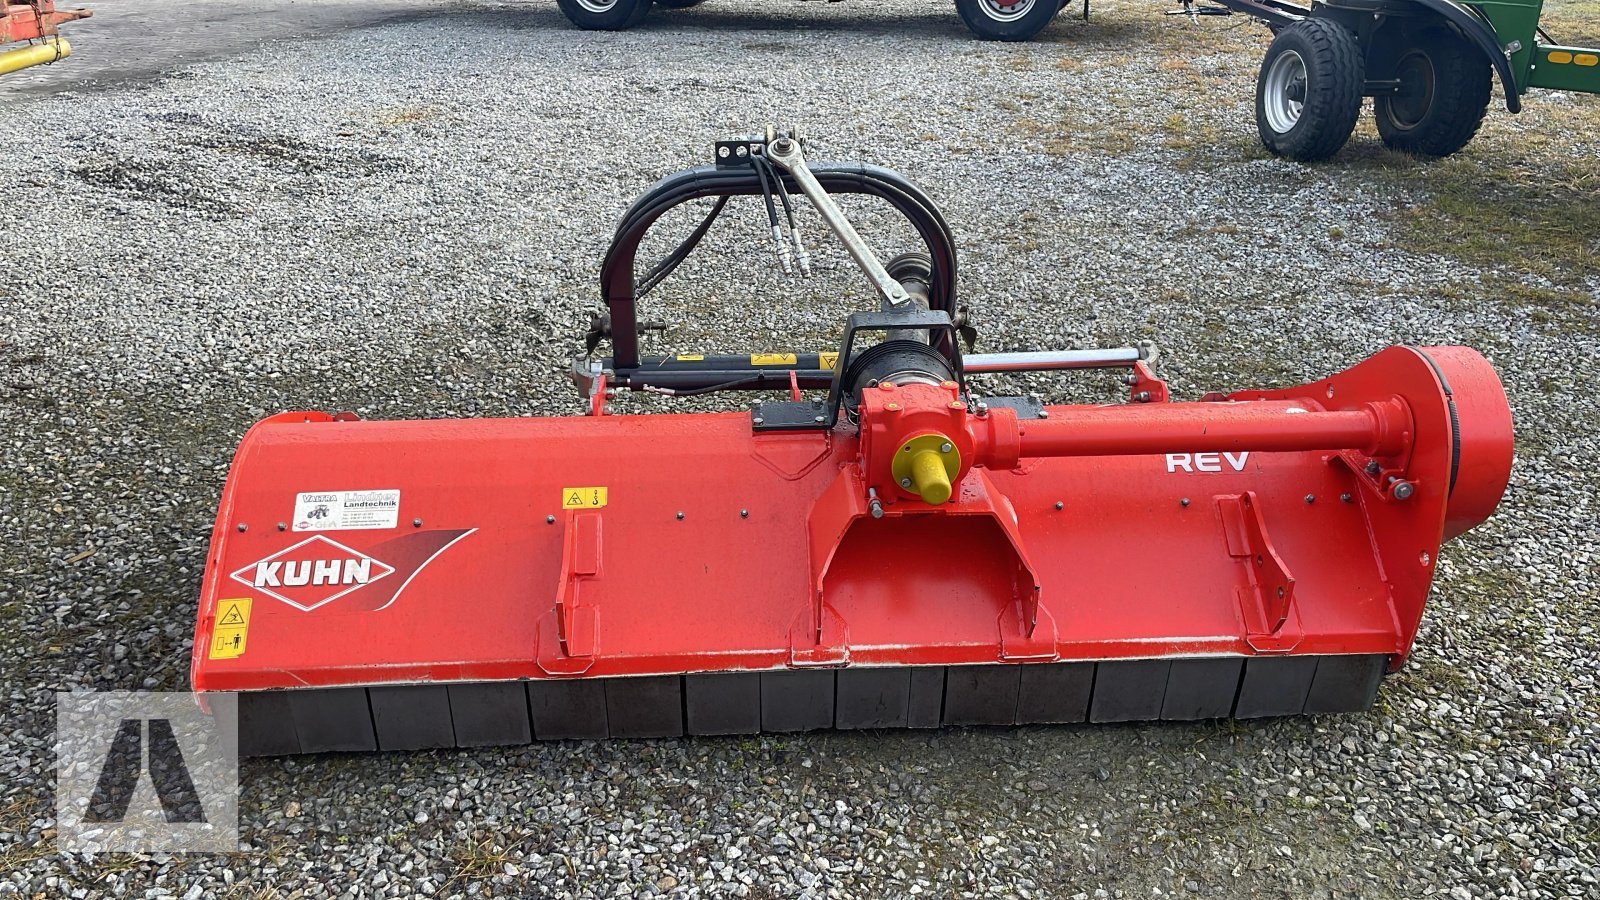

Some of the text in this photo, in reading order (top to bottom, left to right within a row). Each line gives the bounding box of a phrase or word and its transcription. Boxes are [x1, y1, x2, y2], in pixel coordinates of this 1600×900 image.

[1166, 451, 1250, 473] REV
[303, 494, 337, 503] VALTRA
[254, 558, 371, 587] KUHN
